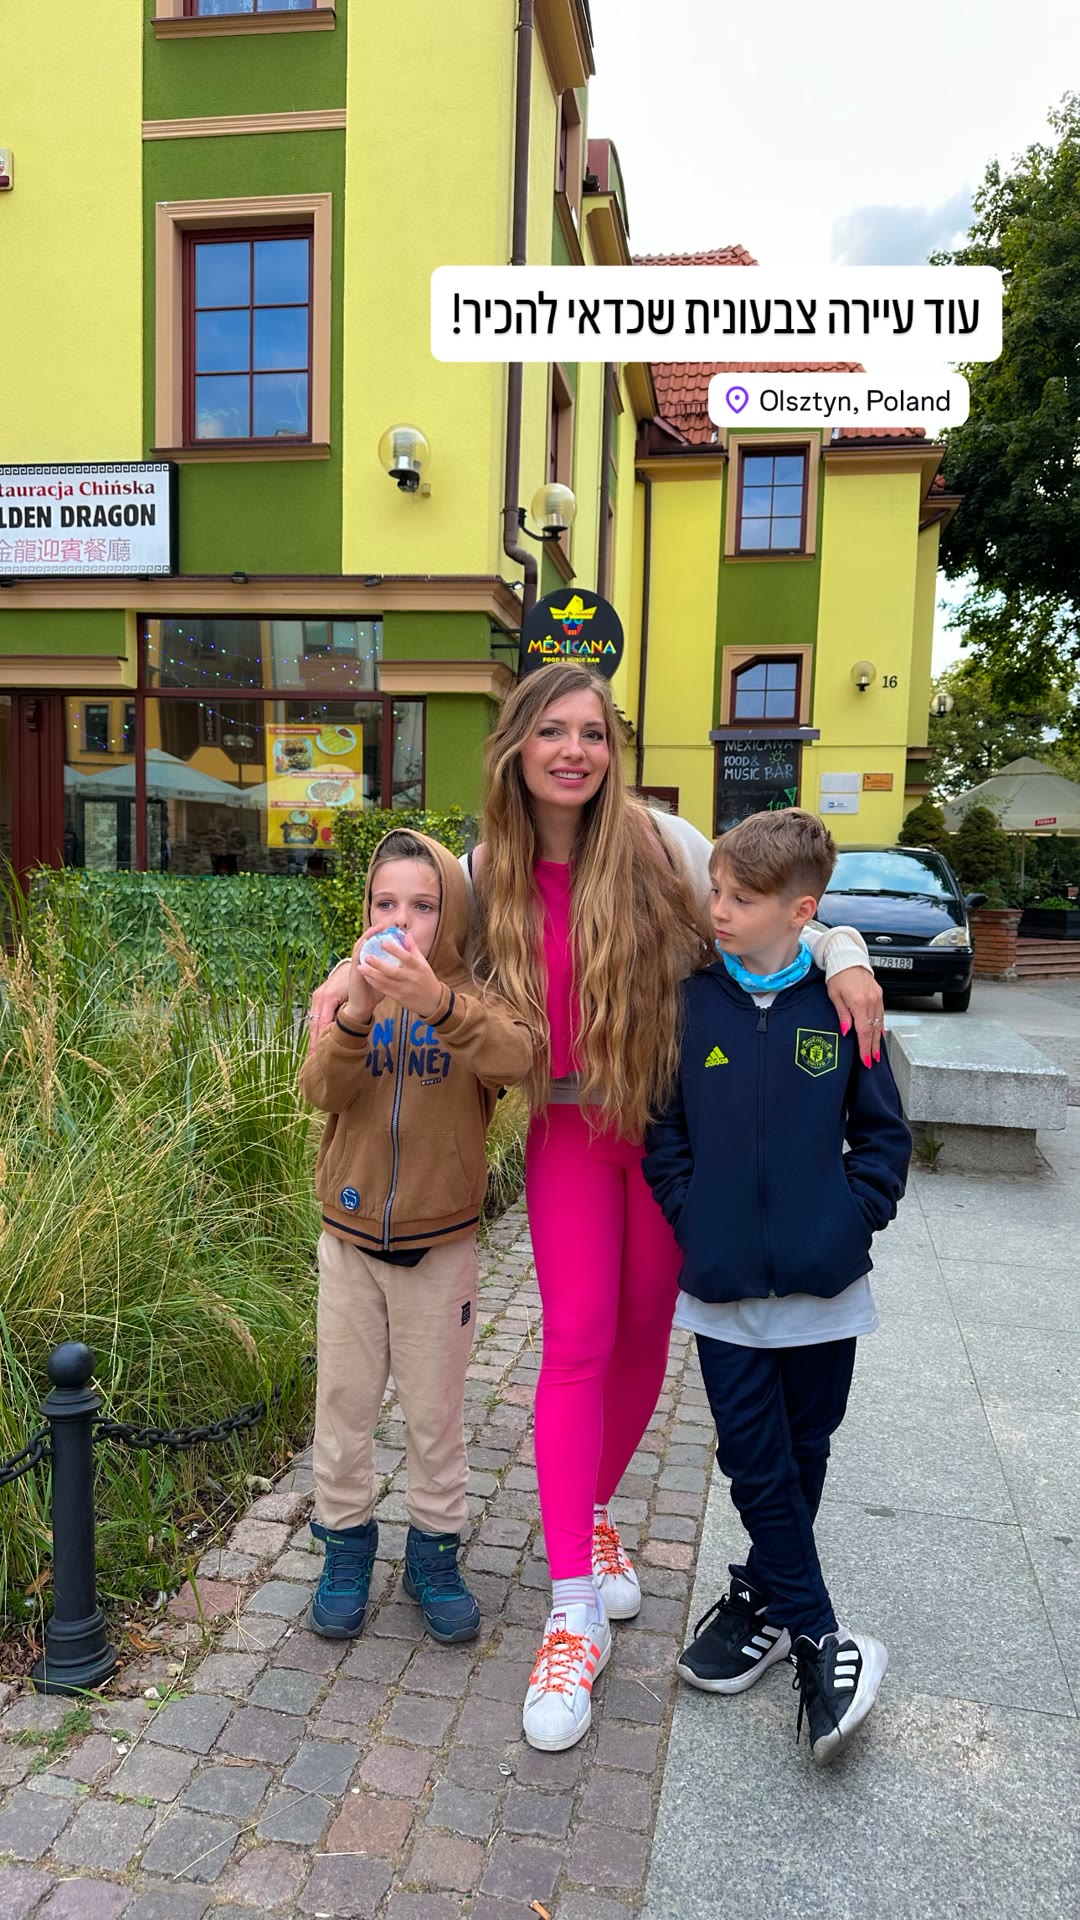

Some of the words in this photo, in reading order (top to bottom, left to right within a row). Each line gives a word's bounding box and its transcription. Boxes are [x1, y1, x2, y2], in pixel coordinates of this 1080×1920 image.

[79, 480, 155, 497] Chińska
[61, 504, 156, 528] DRAGON
[527, 634, 617, 655] MÉXICANA
[882, 675, 898, 689] 16
[724, 767, 760, 780] MUSIC
[764, 764, 794, 780] BAR
[705, 1057, 729, 1067] adidas
